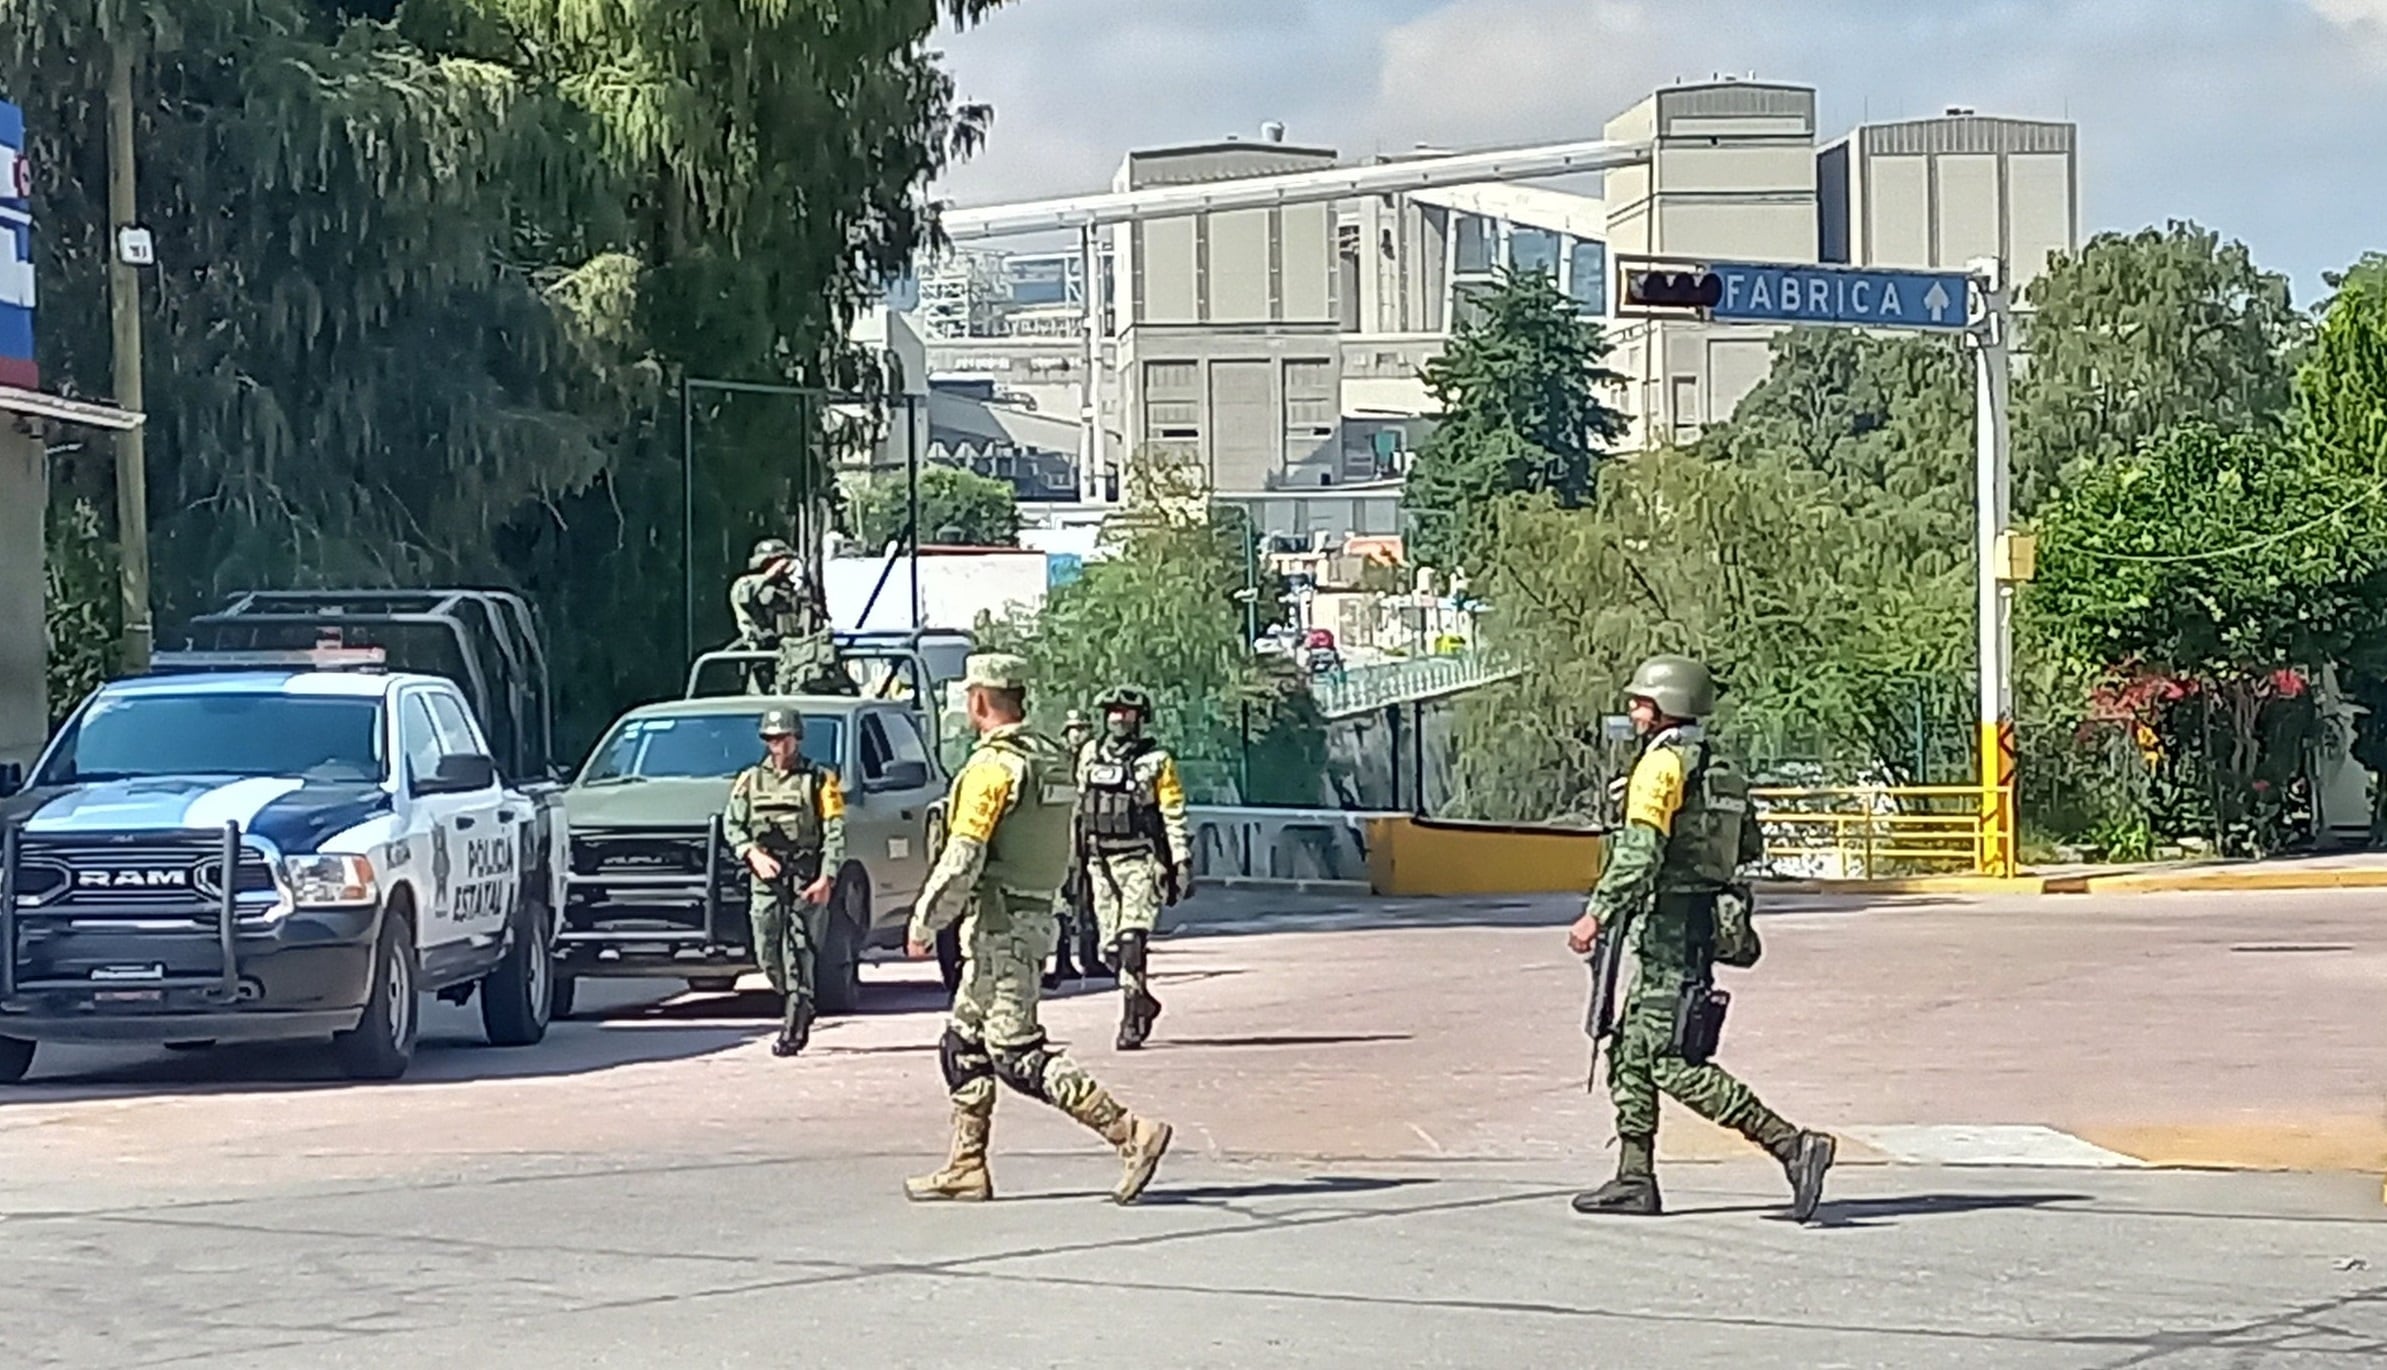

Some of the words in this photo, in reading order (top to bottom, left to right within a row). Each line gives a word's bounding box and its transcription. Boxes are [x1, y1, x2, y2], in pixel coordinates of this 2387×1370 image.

[1726, 274, 1903, 316] FABRICA
[78, 870, 186, 887] RAM
[453, 880, 503, 922] ESTATAL
